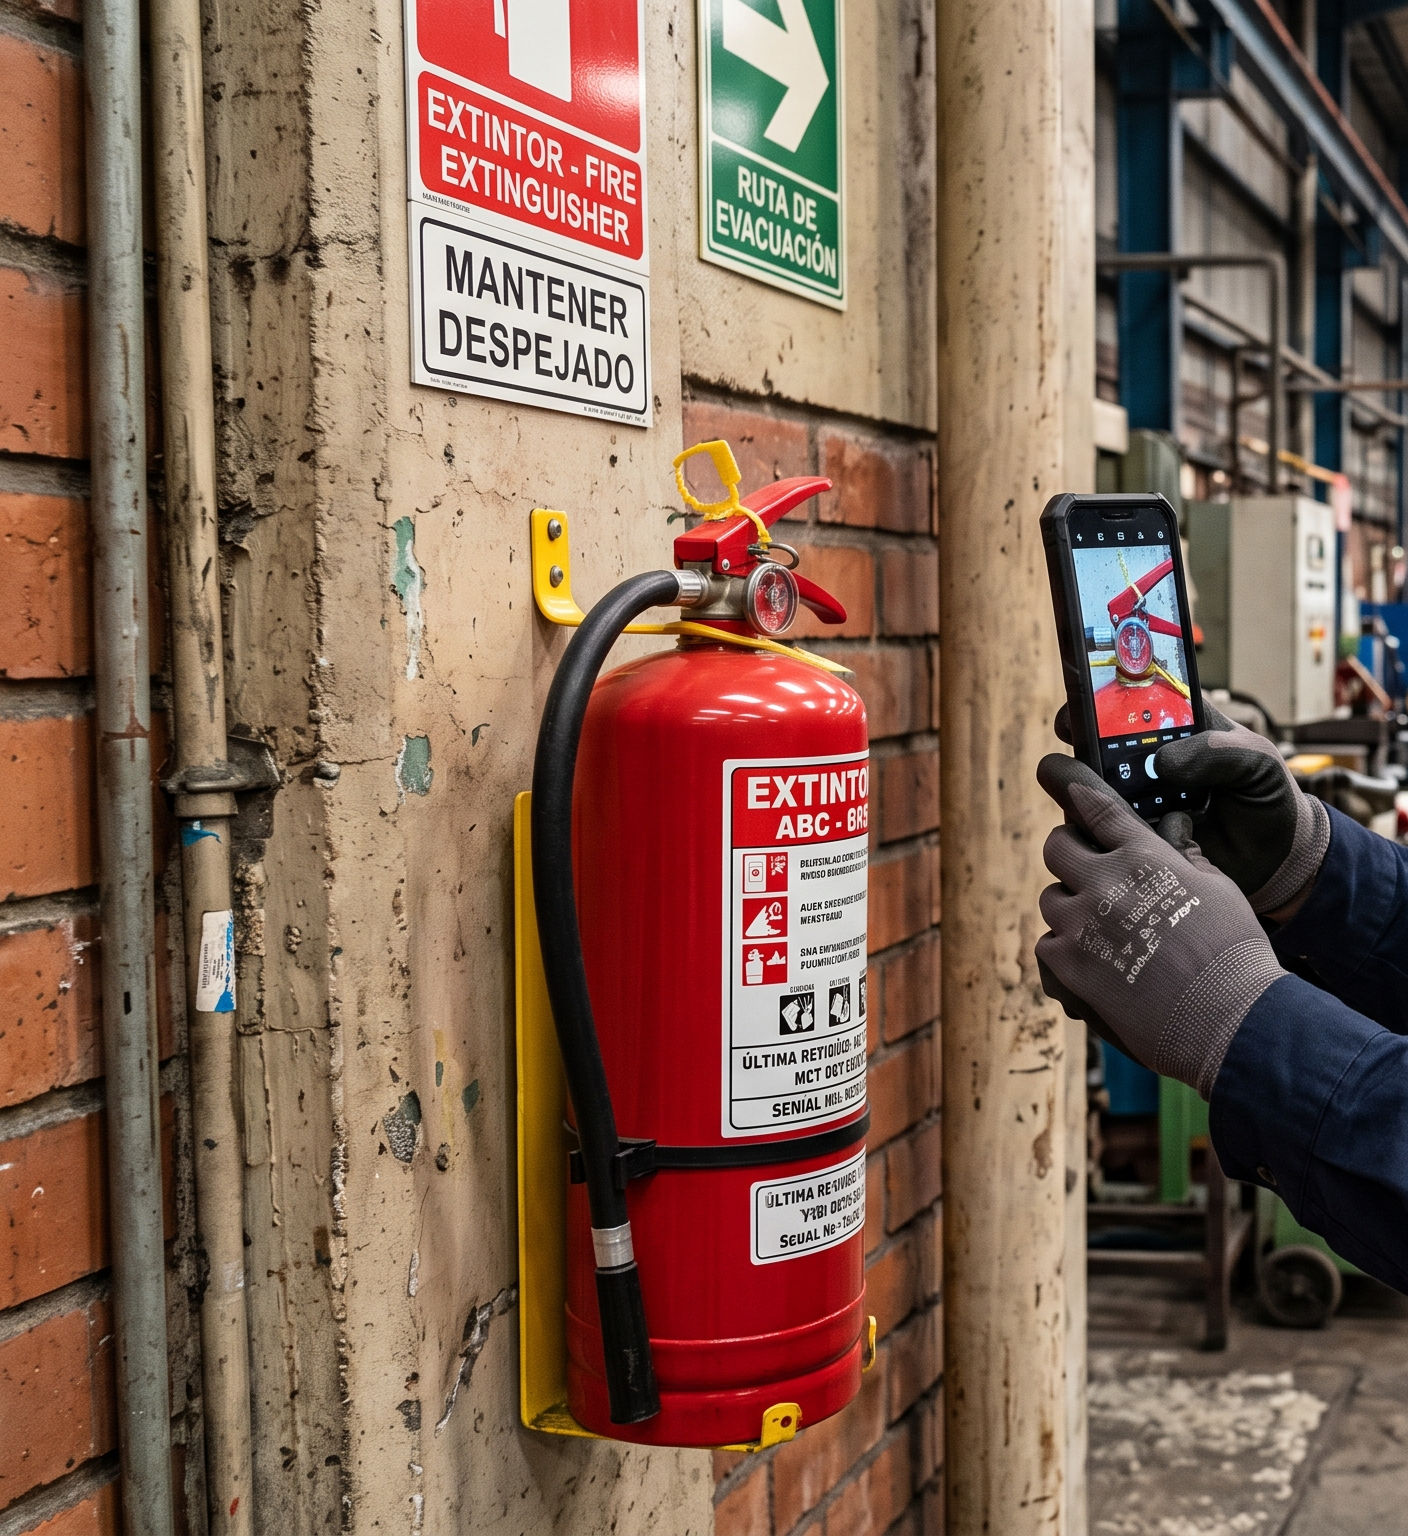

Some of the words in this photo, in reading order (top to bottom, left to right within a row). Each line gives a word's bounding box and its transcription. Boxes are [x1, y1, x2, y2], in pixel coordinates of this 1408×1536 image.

[427, 87, 564, 178] EXTINTOR
[570, 165, 579, 175] -
[585, 154, 637, 206] FIRE
[441, 145, 630, 247] EXTINGUISHER
[738, 165, 789, 217] RUTA
[793, 195, 818, 233] DE
[716, 199, 837, 280] EVACUACIÓN
[445, 244, 629, 339] MANTENER
[439, 309, 634, 395] DESPEJADO
[748, 766, 869, 810] EXTINTO
[775, 812, 830, 840] ABC
[742, 1051, 797, 1070] ÚLTIMA
[795, 1067, 821, 1086] MCT
